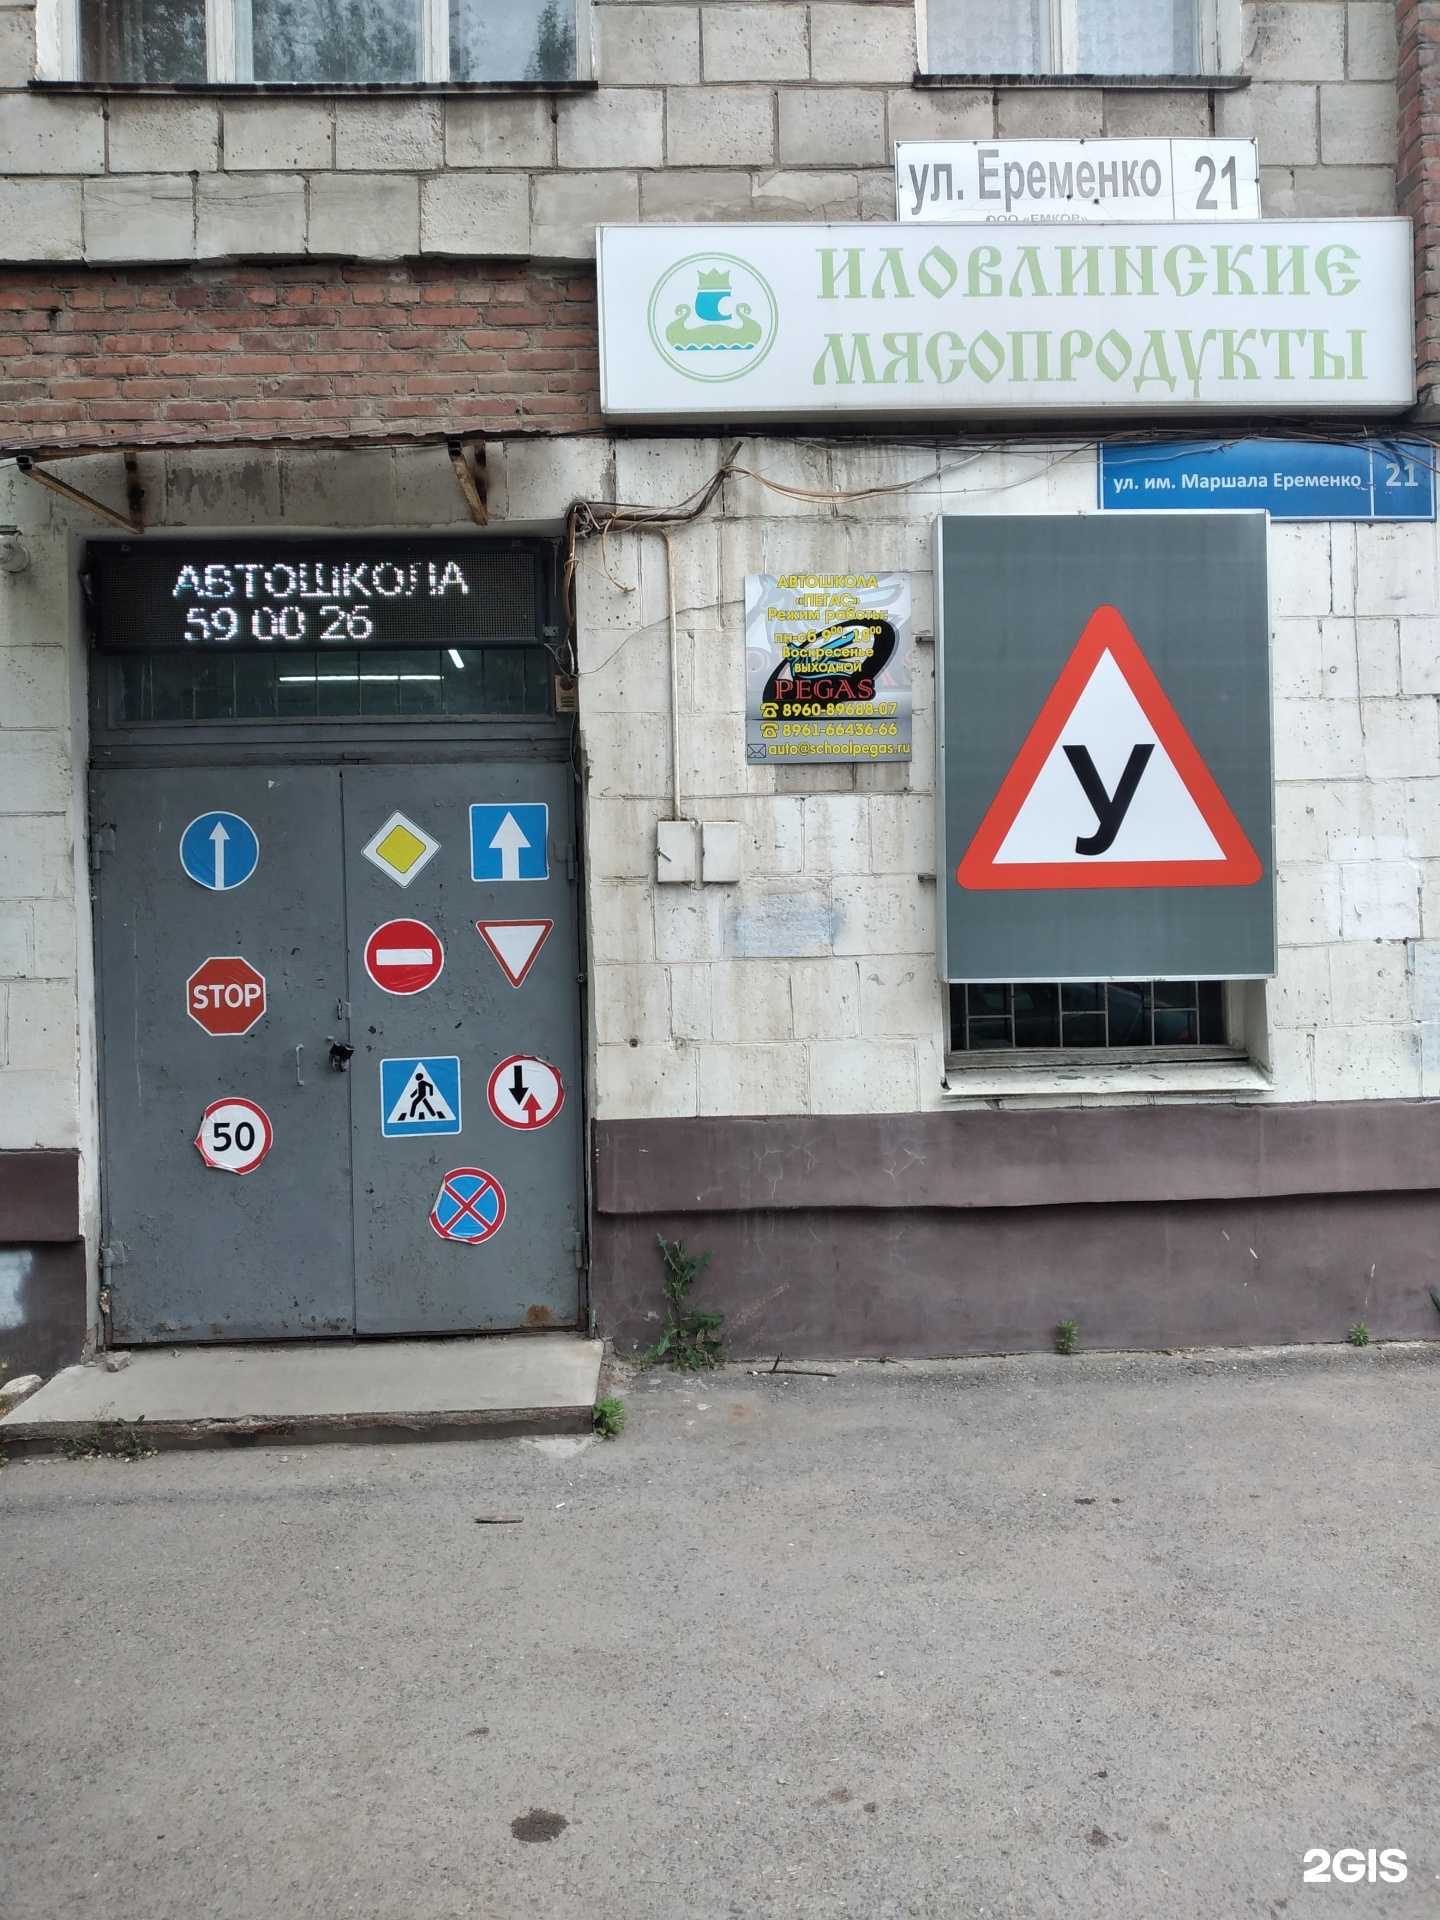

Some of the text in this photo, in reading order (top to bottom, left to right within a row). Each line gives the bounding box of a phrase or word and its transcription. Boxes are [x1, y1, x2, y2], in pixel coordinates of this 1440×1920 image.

[909, 148, 1162, 214] ул. Еременко
[1194, 155, 1238, 210] 21
[815, 244, 1362, 299] ИЛОВЛИНСКИЕ
[812, 328, 1368, 399] МЯСОПРОДУКТЫ
[1113, 472, 1361, 492] ул. им. Маршала Еременко
[1385, 463, 1418, 487] 21
[171, 561, 470, 598] АВТОШКОЛА
[775, 575, 879, 589] АВТОШКОЛА
[184, 605, 374, 641] 59 00 26
[767, 608, 820, 621] Режим
[782, 647, 875, 660] Воскресенье
[794, 660, 862, 673] выходной
[775, 679, 875, 700] PEGAS
[782, 702, 897, 717] 8960-89688-07
[768, 740, 911, 757] auto@schoolpegas.ru
[192, 983, 261, 1009] STOP
[213, 1121, 255, 1152] 50
